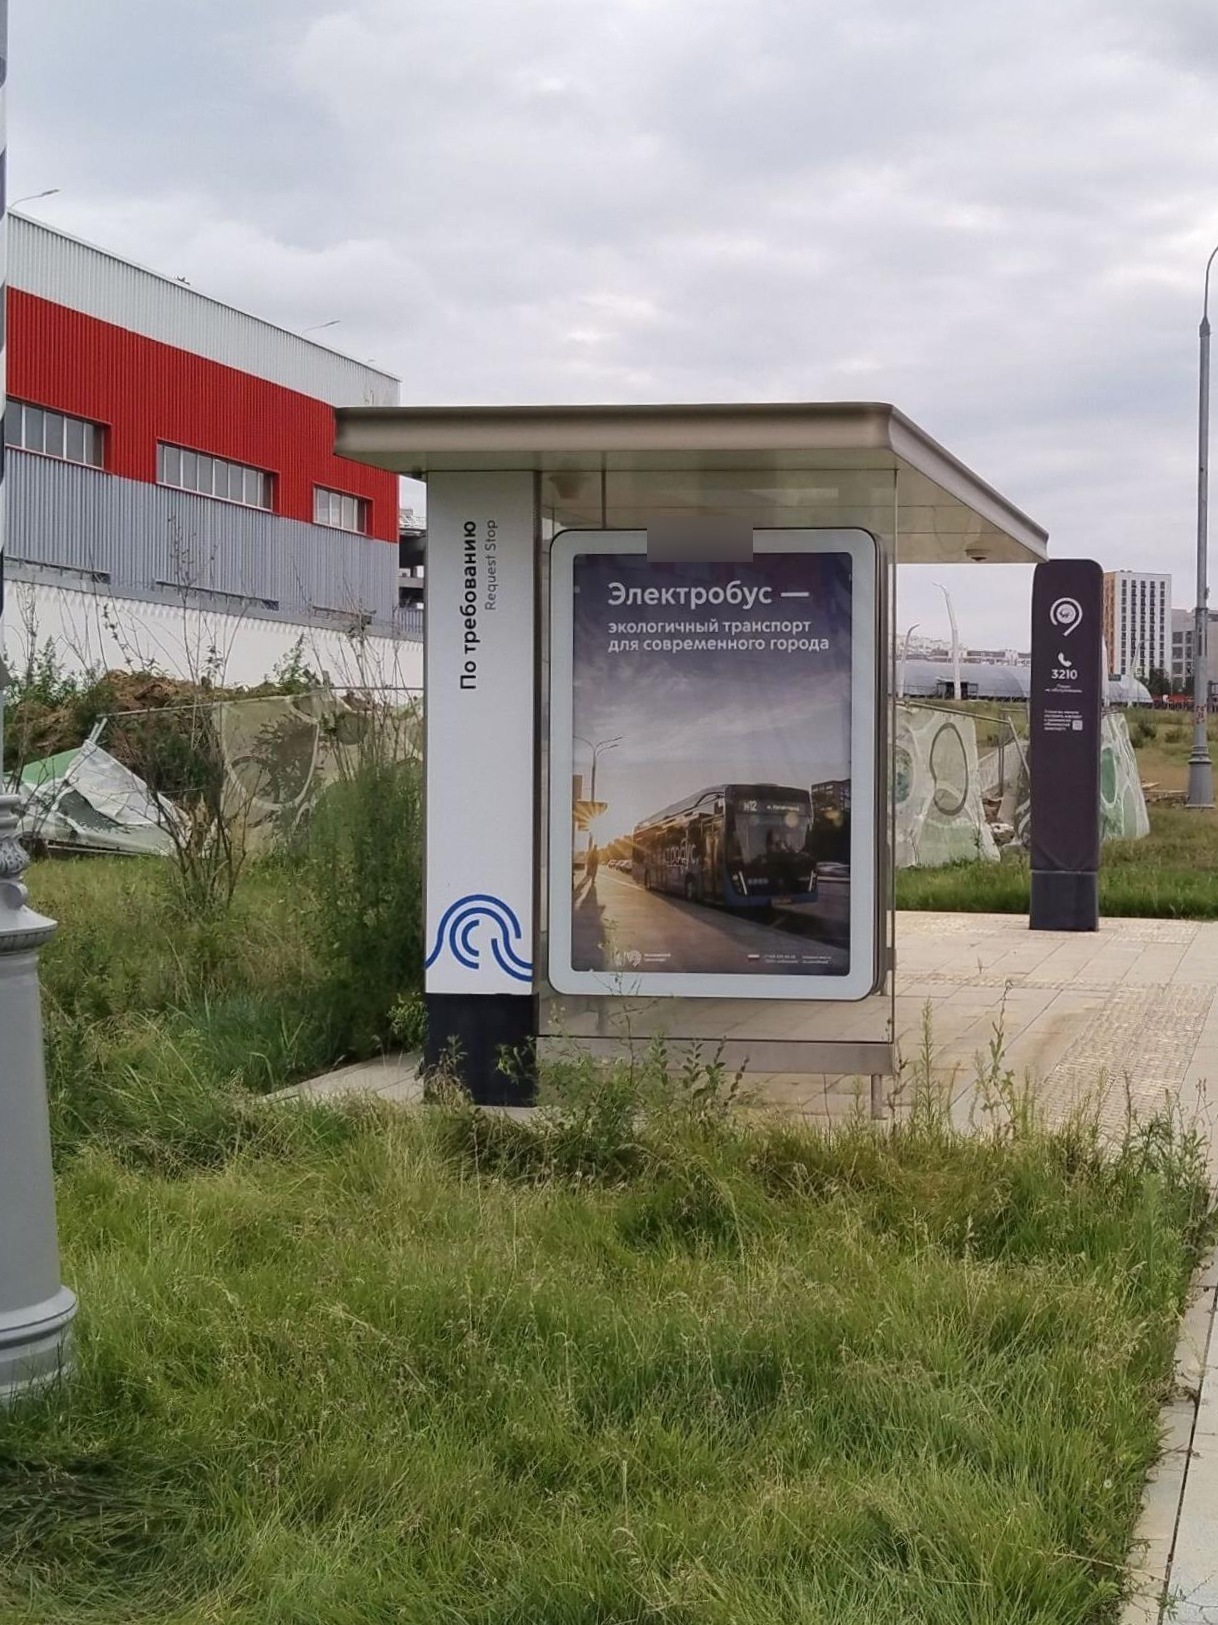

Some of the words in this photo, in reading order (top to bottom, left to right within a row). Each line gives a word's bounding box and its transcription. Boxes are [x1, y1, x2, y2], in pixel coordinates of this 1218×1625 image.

[485, 519, 498, 551] Stop
[460, 520, 481, 654] требованию
[485, 554, 499, 611] Request
[607, 580, 772, 609] Электробус
[608, 618, 719, 634] экологичный
[723, 621, 811, 636] транспорт
[608, 639, 639, 653] для
[643, 638, 766, 654] современного
[770, 638, 829, 654] города
[460, 660, 477, 690] По
[1051, 669, 1078, 679] 3210
